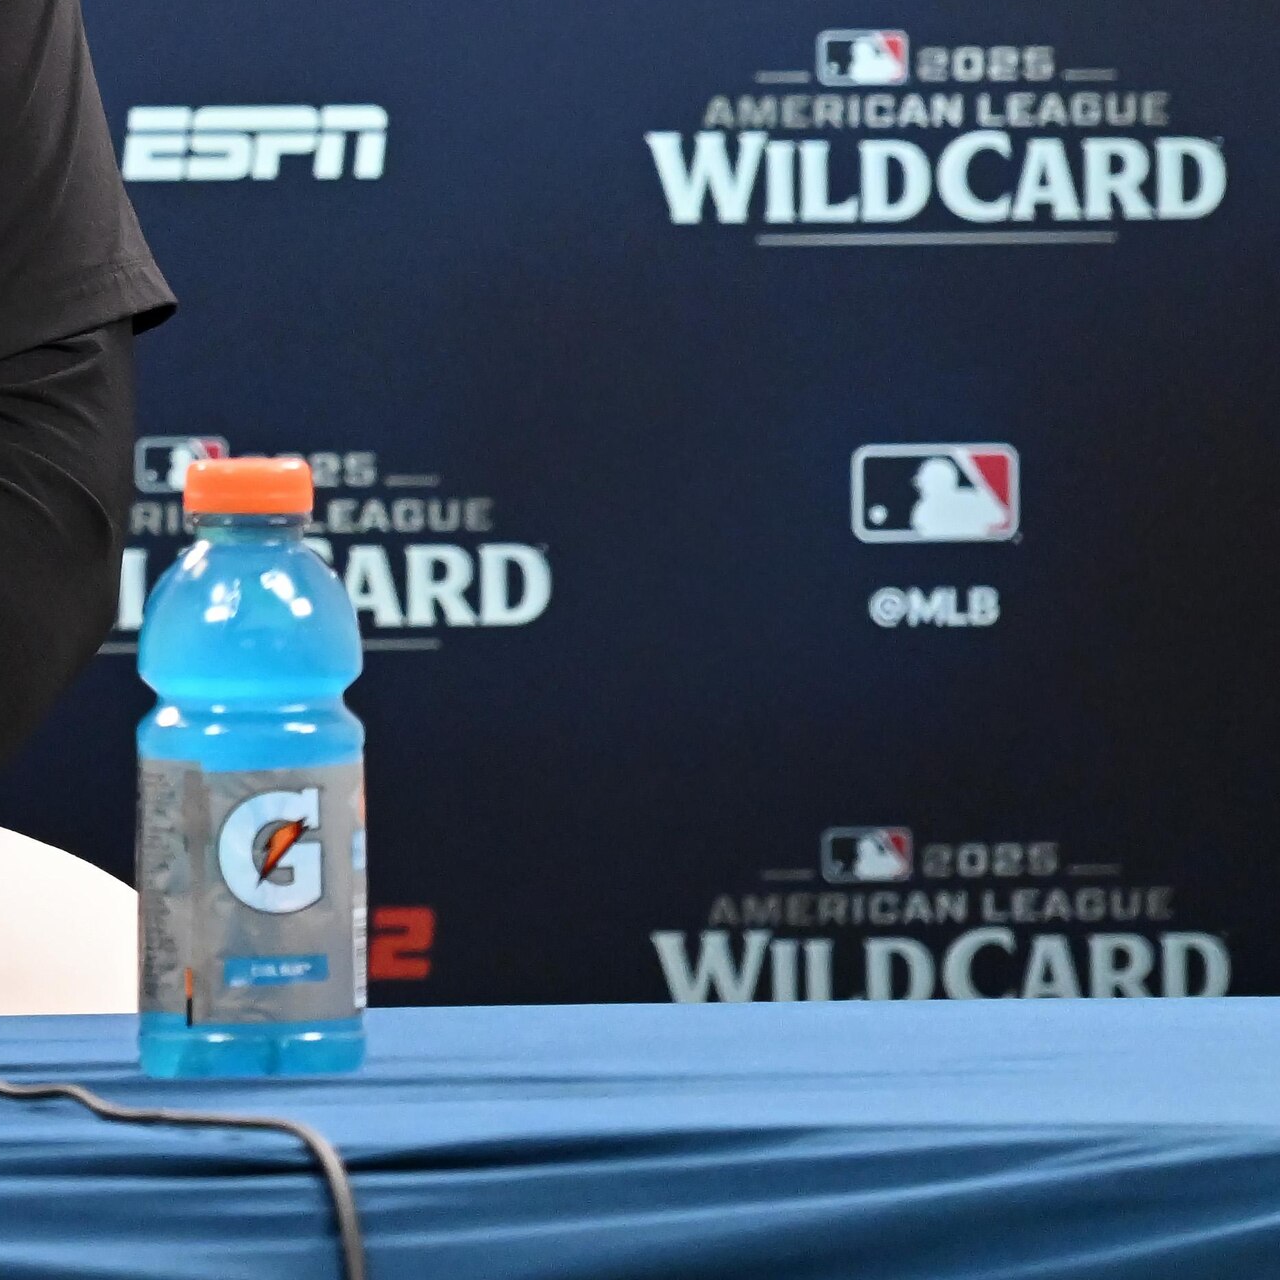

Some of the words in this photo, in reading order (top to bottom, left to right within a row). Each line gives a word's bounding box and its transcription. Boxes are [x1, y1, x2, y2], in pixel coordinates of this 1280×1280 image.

[917, 46, 1054, 81] 2025
[705, 94, 963, 128] AMERICAN
[975, 92, 1169, 127] LEAGUE
[122, 105, 388, 181] ESPN
[869, 587, 999, 627] @MLB
[219, 788, 322, 914] G
[923, 843, 1057, 877] 2025
[709, 891, 967, 926] AMERICAN
[982, 888, 1172, 922] LEAGUE
